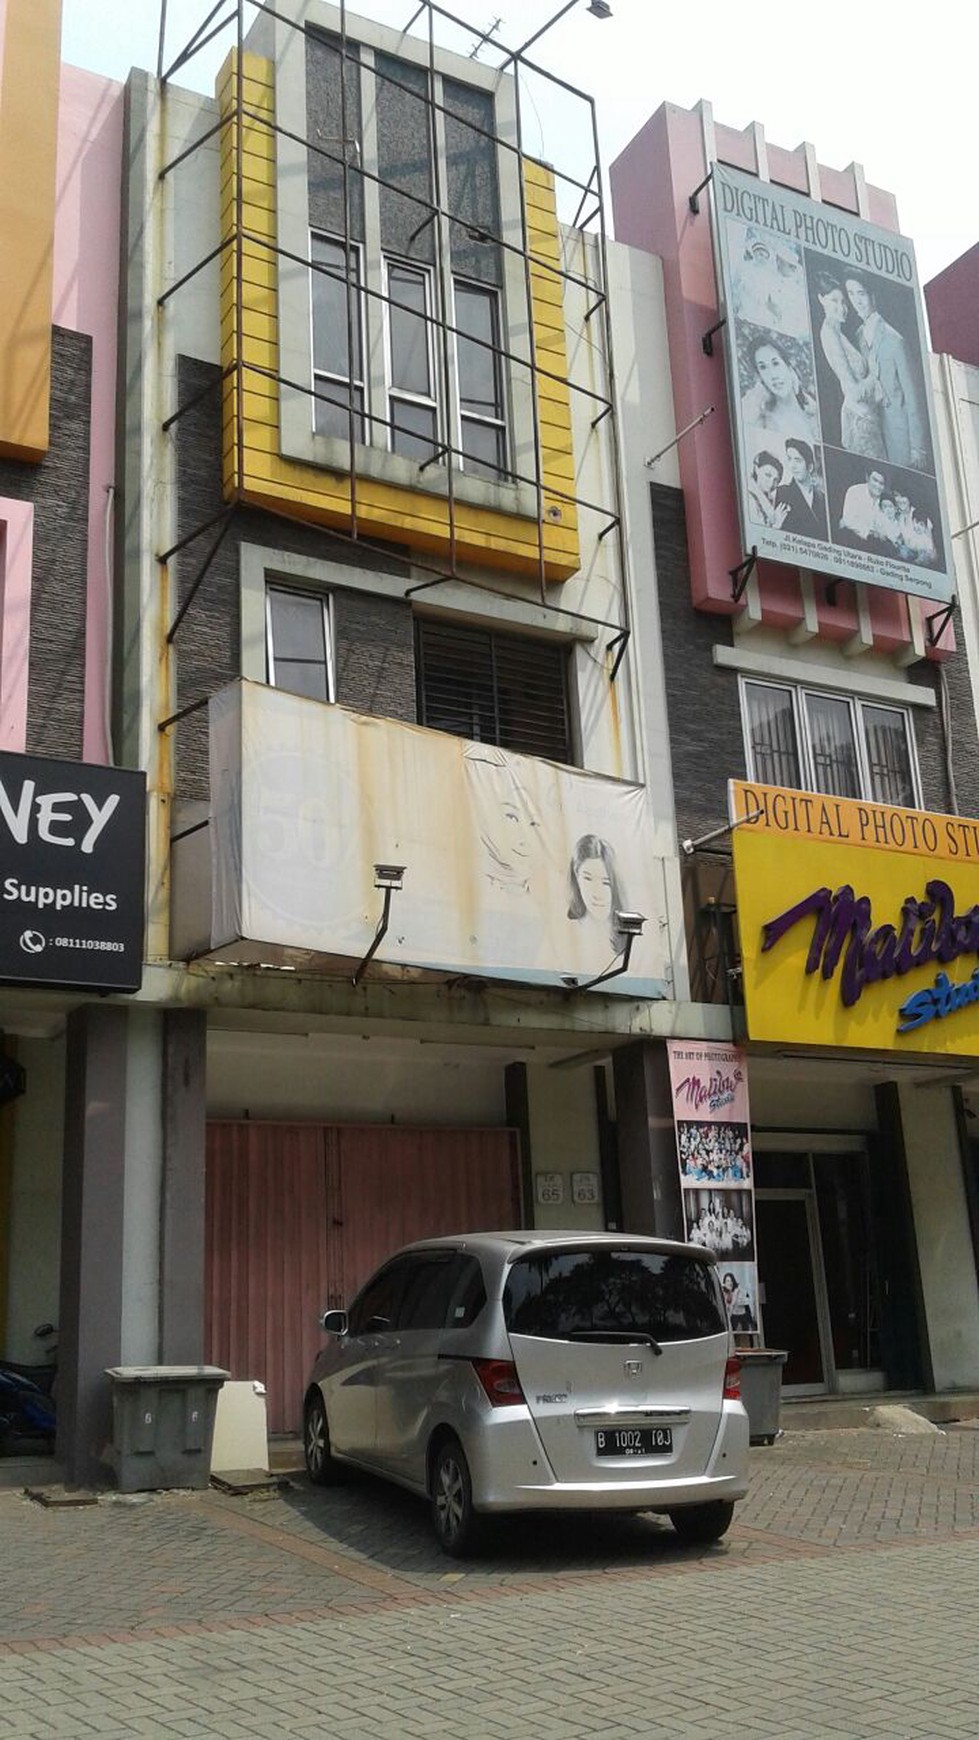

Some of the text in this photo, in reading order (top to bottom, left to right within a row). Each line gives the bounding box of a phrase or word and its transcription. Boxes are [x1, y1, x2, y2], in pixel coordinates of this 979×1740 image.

[720, 181, 912, 282] DIGITAL PHOTO STUDIO
[743, 788, 849, 839] DIGITAL
[857, 806, 938, 852] PHOTO
[3, 878, 118, 910] Supplies
[55, 936, 125, 953] 08111038803
[673, 1050, 684, 1060] THE
[685, 1051, 695, 1060] ART
[696, 1052, 703, 1061] OF
[675, 1070, 737, 1110] Malibu
[542, 1188, 561, 1201] 65
[578, 1188, 596, 1201] 63
[597, 1432, 606, 1448] B
[615, 1431, 641, 1447] 1002
